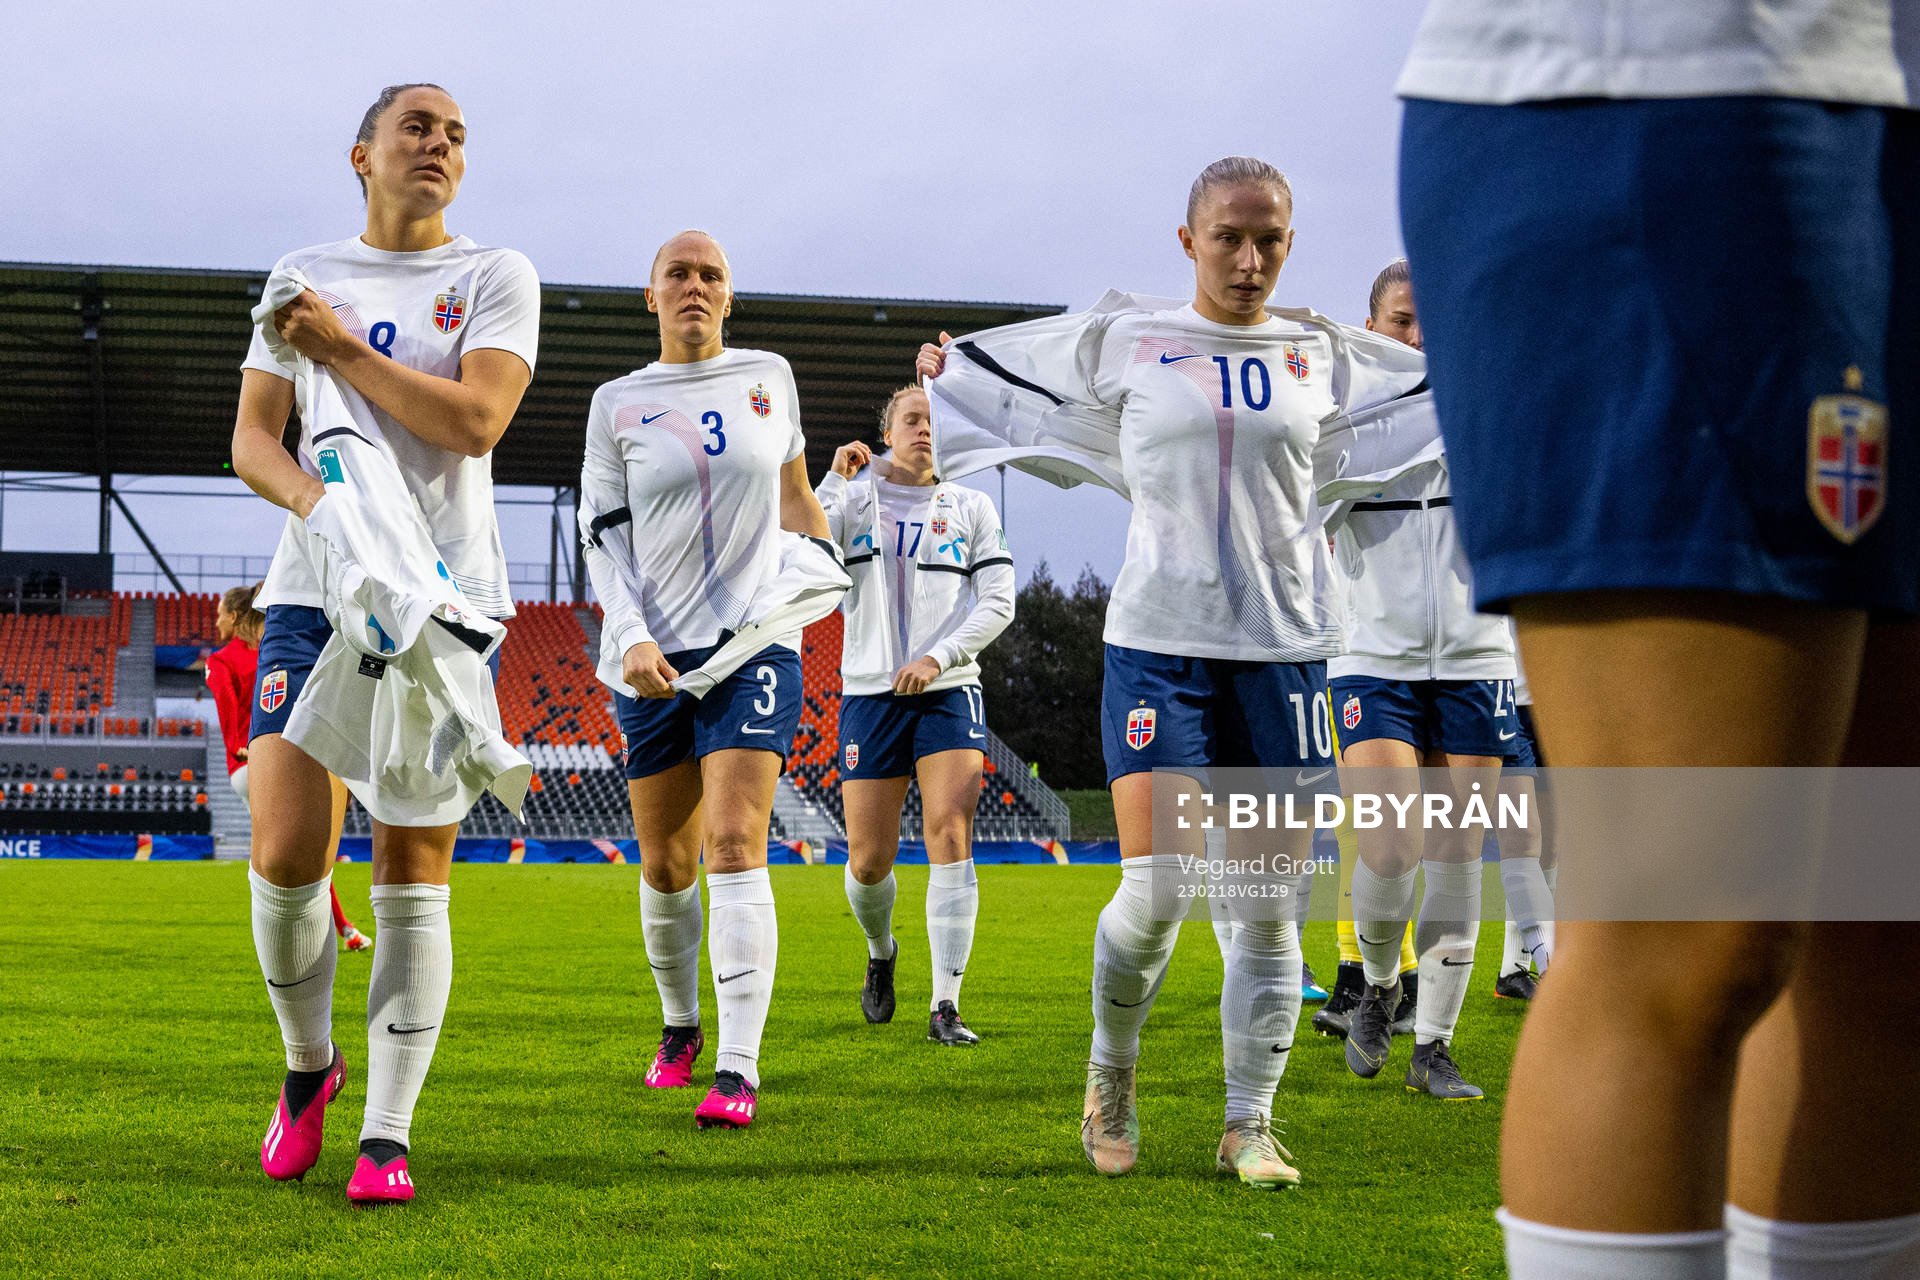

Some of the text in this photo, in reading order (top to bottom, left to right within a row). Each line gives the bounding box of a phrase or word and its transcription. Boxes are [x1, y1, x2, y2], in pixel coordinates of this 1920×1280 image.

[1212, 356, 1272, 411] 10
[701, 411, 727, 456] 3
[896, 520, 924, 557] 17
[754, 665, 777, 716] 3
[962, 685, 983, 725] 17
[1289, 692, 1332, 759] 10
